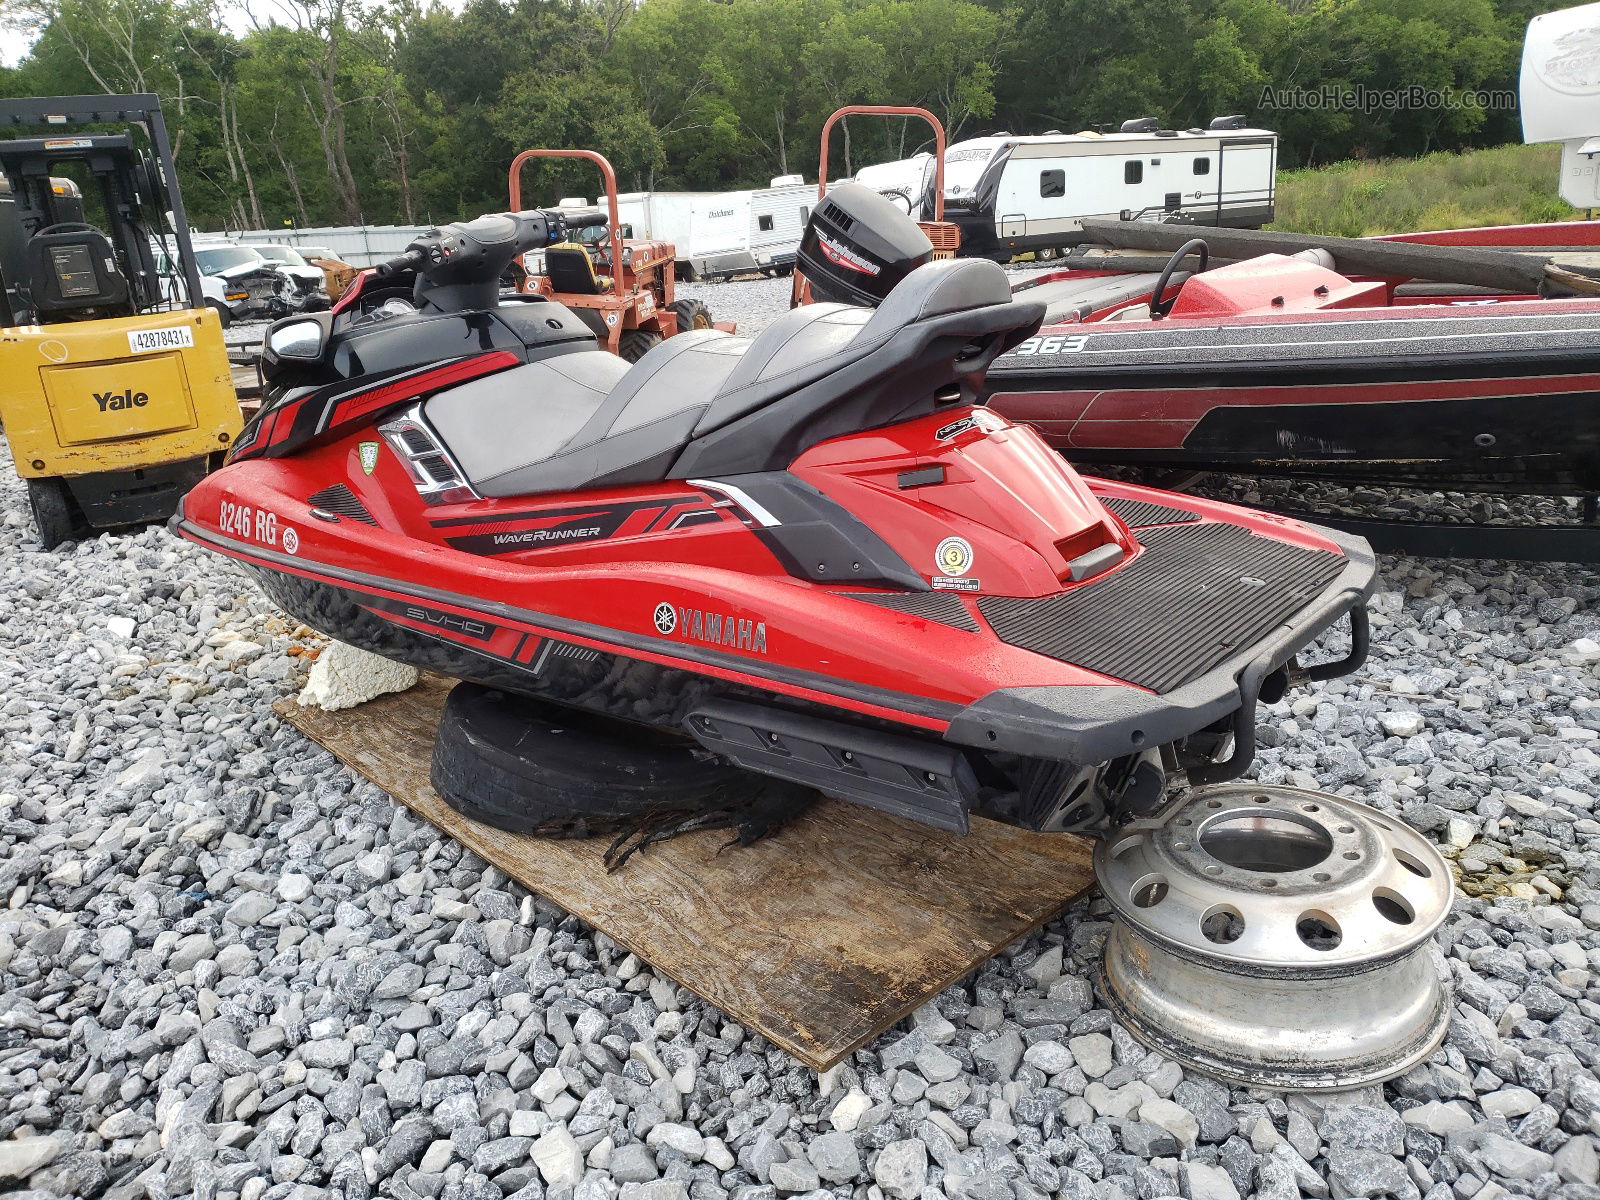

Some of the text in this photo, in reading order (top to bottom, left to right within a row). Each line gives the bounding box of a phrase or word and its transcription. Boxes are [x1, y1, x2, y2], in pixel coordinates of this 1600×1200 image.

[1017, 334, 1090, 356] 363
[92, 389, 149, 412] Yale
[219, 501, 277, 545] 8246 RG
[406, 607, 486, 635] SVHO
[678, 606, 767, 654] YAMAHA
